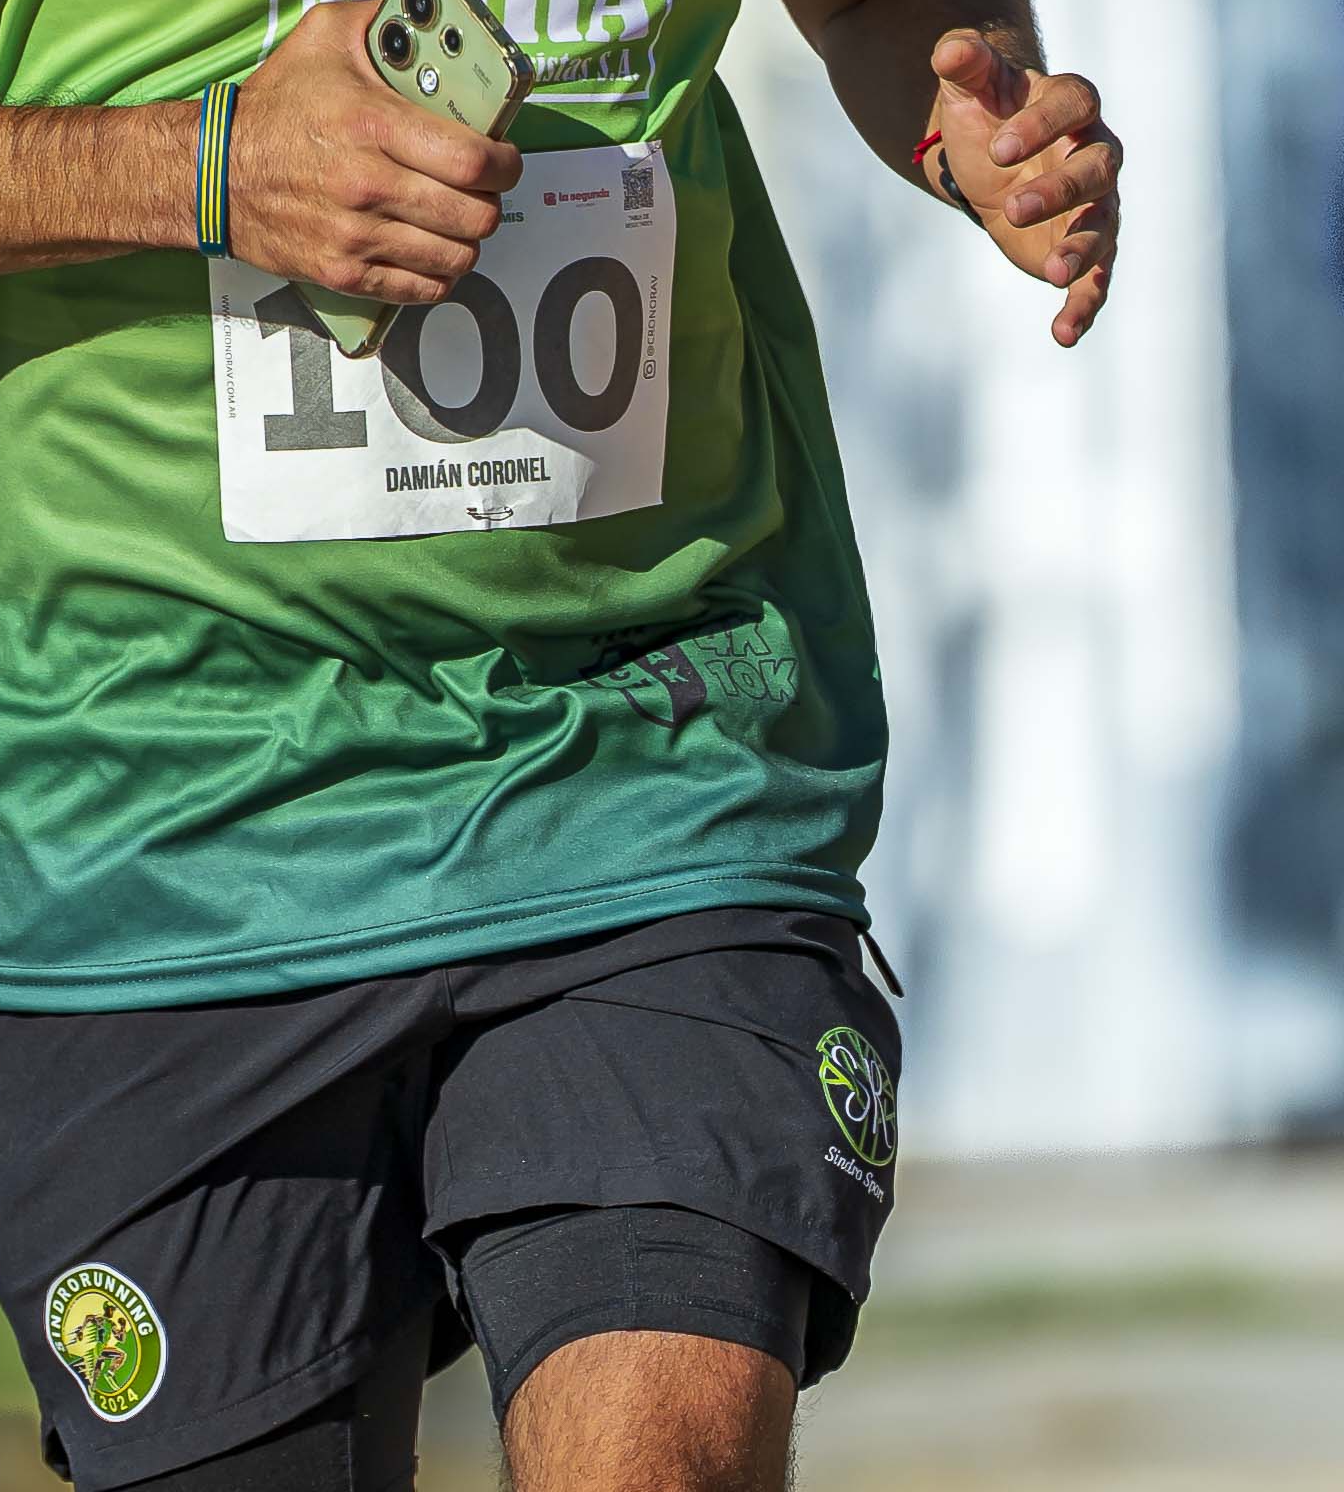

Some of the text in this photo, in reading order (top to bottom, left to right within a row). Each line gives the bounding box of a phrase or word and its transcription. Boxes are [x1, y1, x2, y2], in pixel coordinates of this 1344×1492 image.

[253, 256, 644, 452] 100
[385, 456, 551, 493] DAMIÁN CORONEL
[704, 658, 797, 702] 10K
[823, 1145, 864, 1182] Sindro
[51, 1271, 154, 1354] SINDRORUNNING
[99, 1387, 140, 1413] 2024
